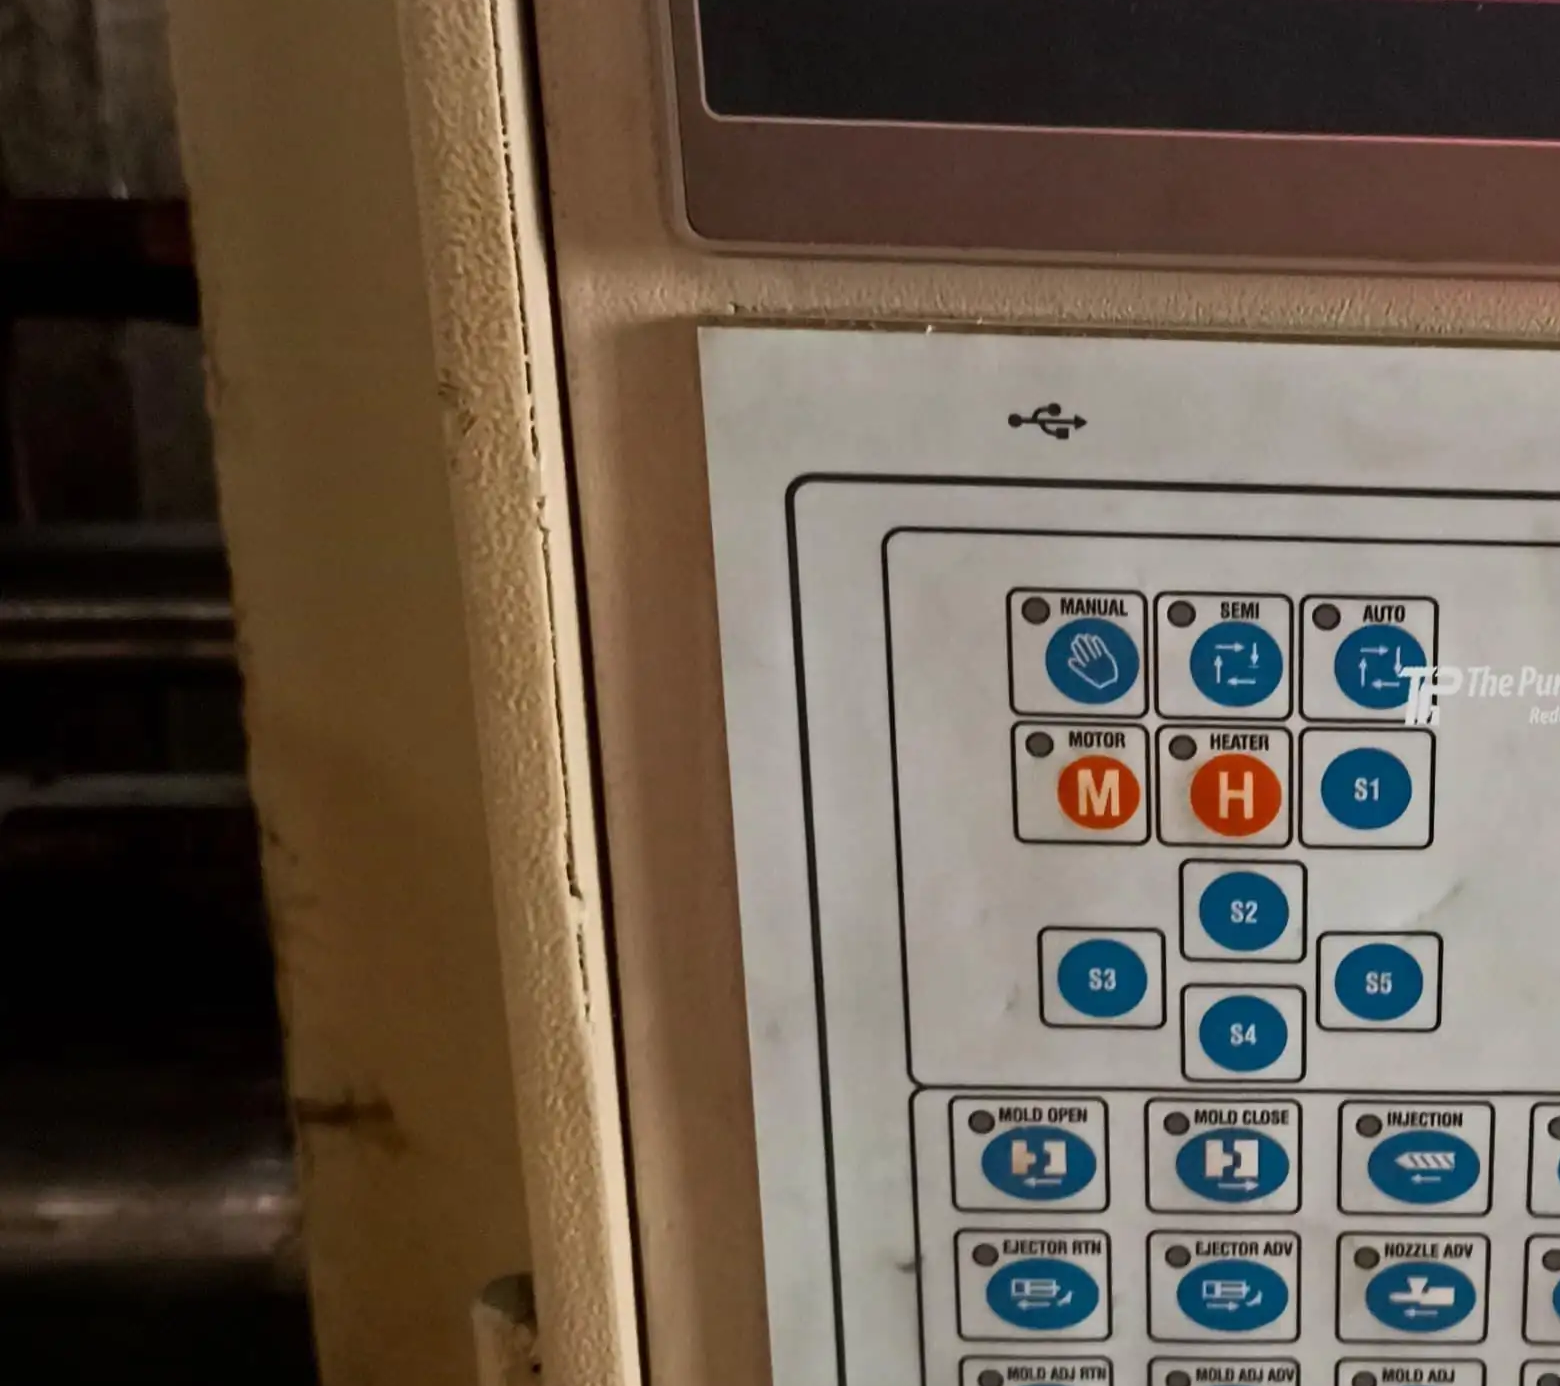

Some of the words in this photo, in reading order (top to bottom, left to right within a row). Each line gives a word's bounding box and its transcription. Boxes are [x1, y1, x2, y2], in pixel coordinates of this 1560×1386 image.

[1060, 597, 1128, 618] MANUAL
[1220, 601, 1260, 620] SEMI
[1362, 604, 1406, 624] AUTO
[1068, 730, 1126, 749] MOTOR
[1209, 733, 1270, 752] HEATER
[1077, 768, 1120, 817] M
[1219, 771, 1254, 820] H
[1354, 777, 1379, 801] S1
[1230, 900, 1258, 923] S2
[1089, 968, 1117, 990] S3
[1366, 972, 1392, 994] S5
[1230, 1023, 1257, 1045] S4
[998, 1107, 1042, 1123] MOLD
[1046, 1107, 1088, 1124] OPEN
[1194, 1108, 1238, 1126] MOLD
[1242, 1109, 1289, 1126] CLOSE
[1387, 1111, 1463, 1128] INJECTION
[1002, 1239, 1068, 1255] EJECTOR
[1072, 1240, 1102, 1255] RTN
[1195, 1240, 1259, 1257] EJECTOR
[1264, 1241, 1293, 1257] ADV
[1384, 1242, 1438, 1259] NOZZLE
[1442, 1243, 1474, 1259] ADV
[1007, 1366, 1046, 1381] MOLD
[1050, 1366, 1076, 1382] ADJ
[1079, 1366, 1107, 1380] RTN
[1195, 1367, 1235, 1383] MOLD
[1238, 1368, 1264, 1384] ADJ
[1267, 1368, 1295, 1383] ADV
[1381, 1368, 1424, 1383] MOLD
[1427, 1368, 1456, 1384] ADJ
